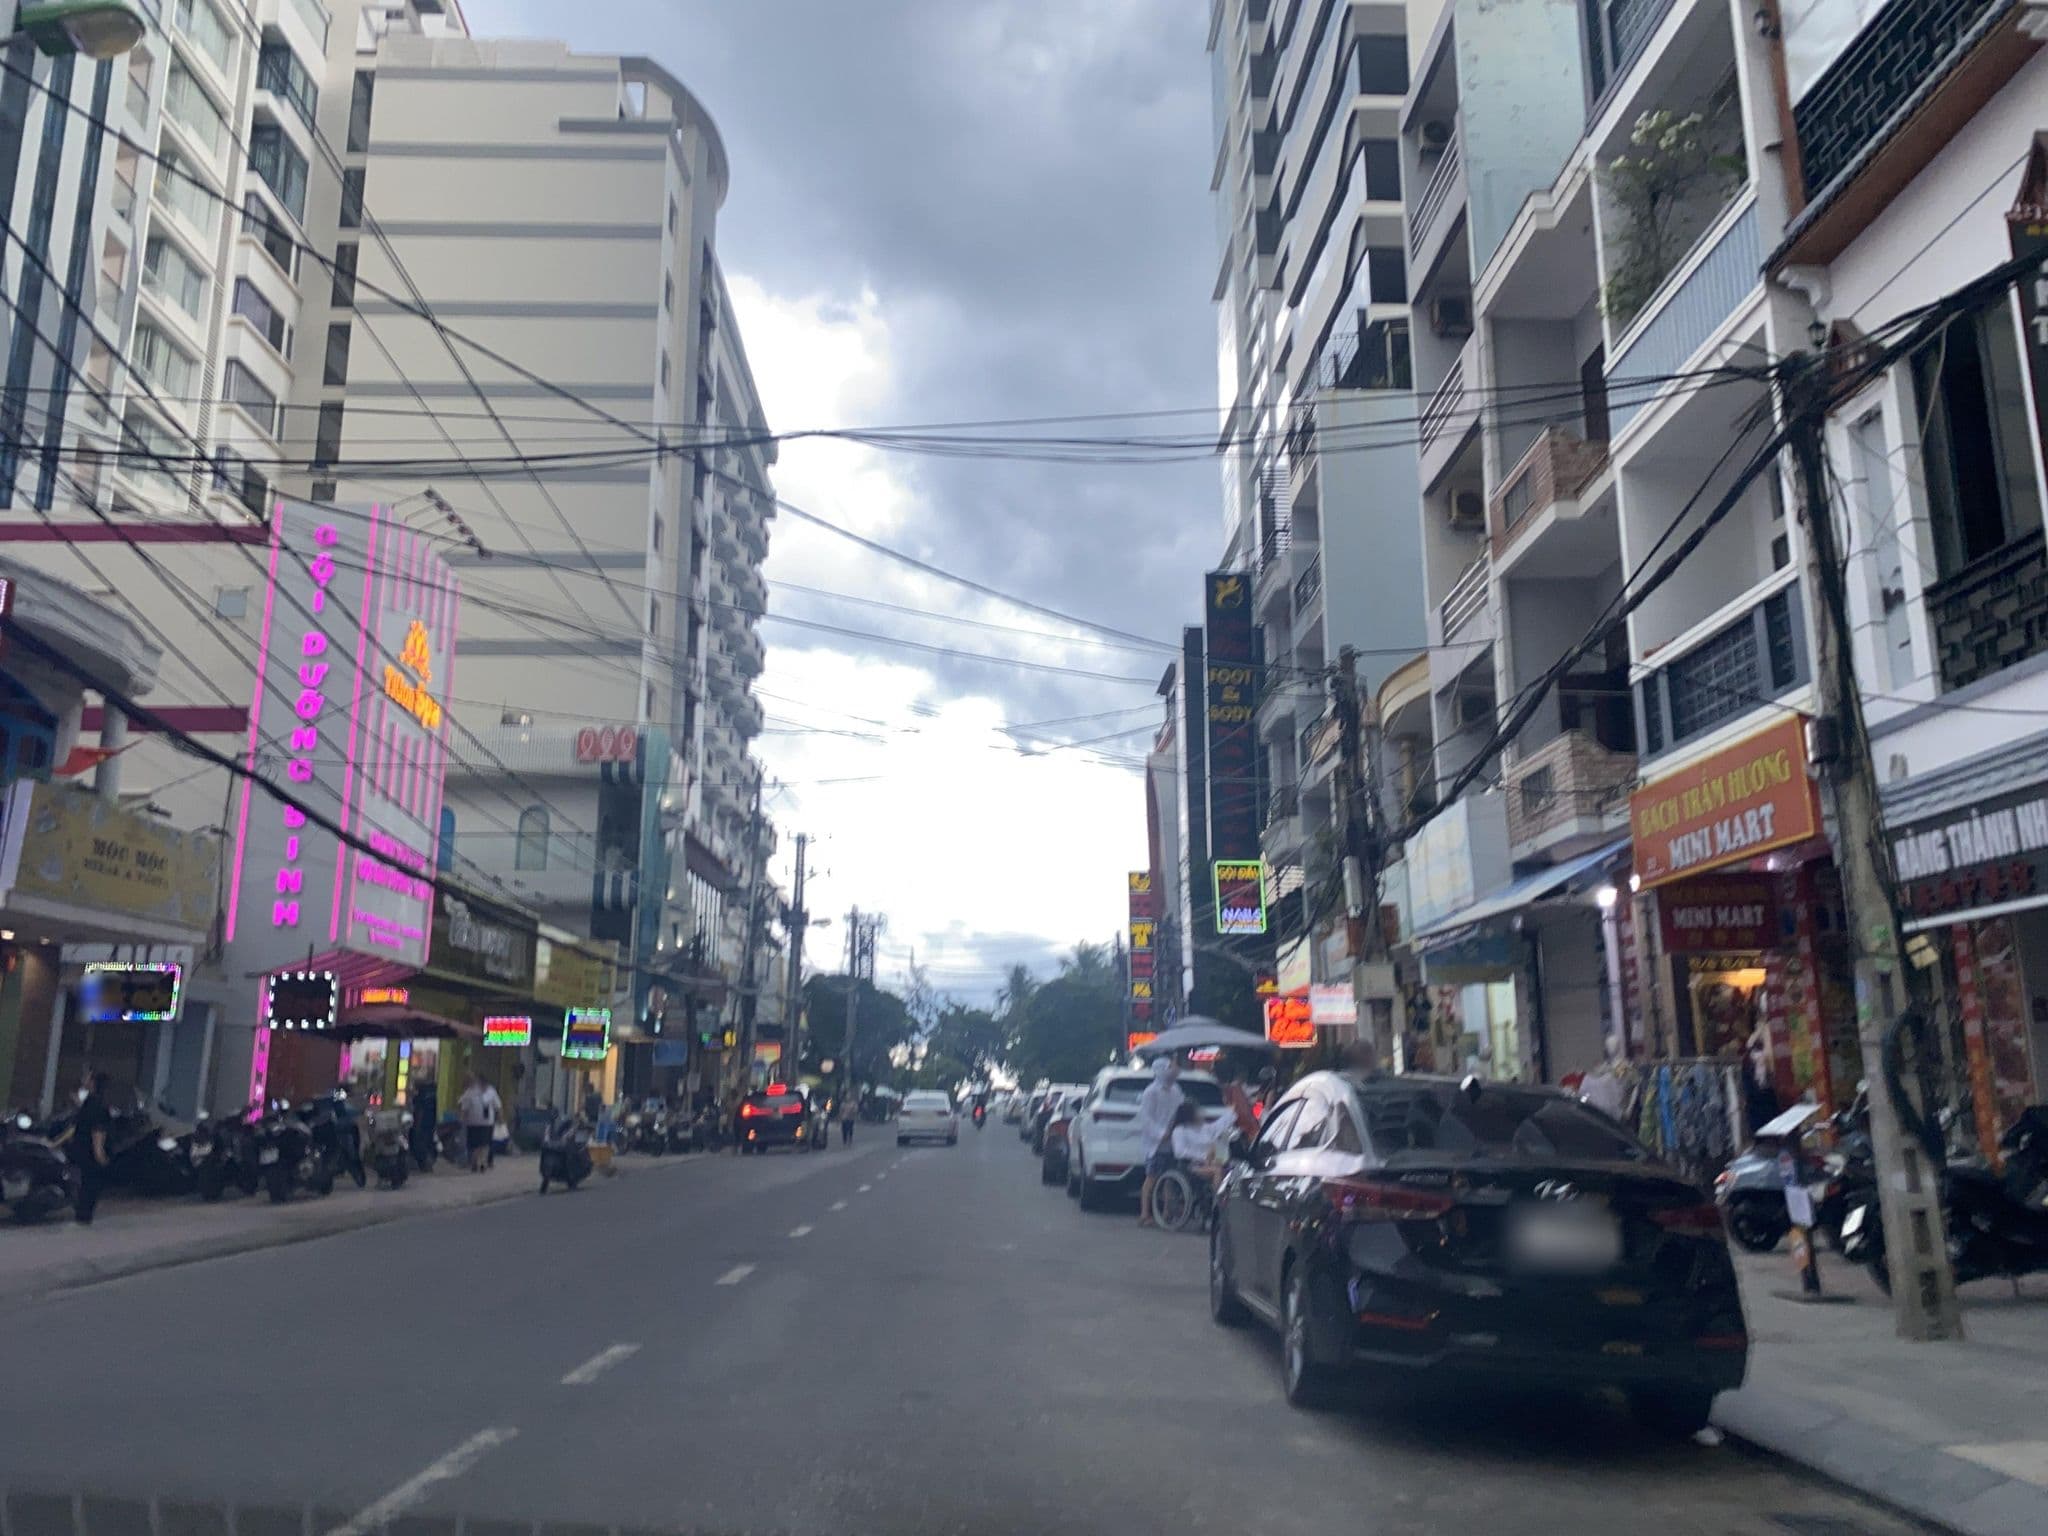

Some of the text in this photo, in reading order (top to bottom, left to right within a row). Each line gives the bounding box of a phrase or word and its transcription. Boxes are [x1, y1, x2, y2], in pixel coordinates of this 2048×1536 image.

[1668, 823, 1714, 871] MINI
[1713, 802, 1776, 855] MART
[1714, 903, 1765, 928] MART
